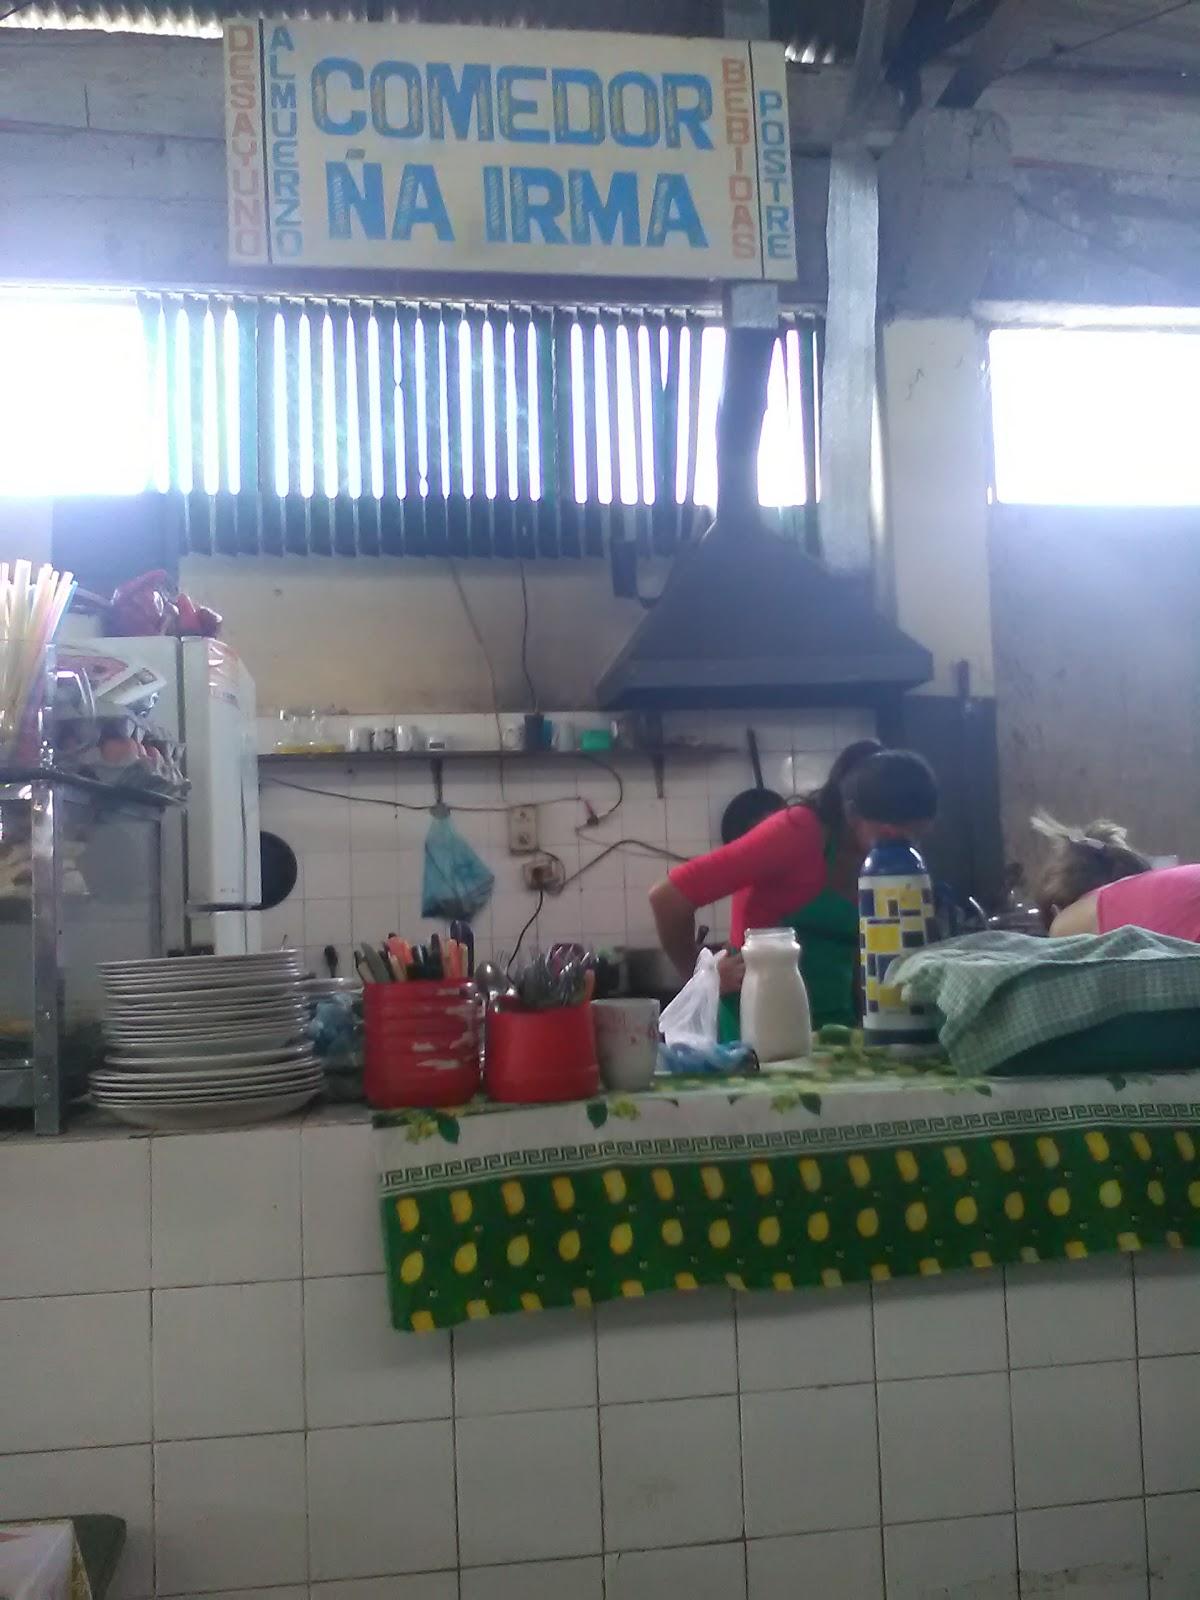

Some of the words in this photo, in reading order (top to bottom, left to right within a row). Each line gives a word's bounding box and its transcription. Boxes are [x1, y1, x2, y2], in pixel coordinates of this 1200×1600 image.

[228, 26, 261, 257] DESAYUNO
[270, 26, 303, 257] ALMUERZO
[311, 57, 713, 150] COMEDOR
[722, 58, 755, 259] BEBIDAS
[759, 90, 793, 259] POSTRE
[325, 149, 455, 241] ÑA
[483, 165, 709, 248] IRMA
